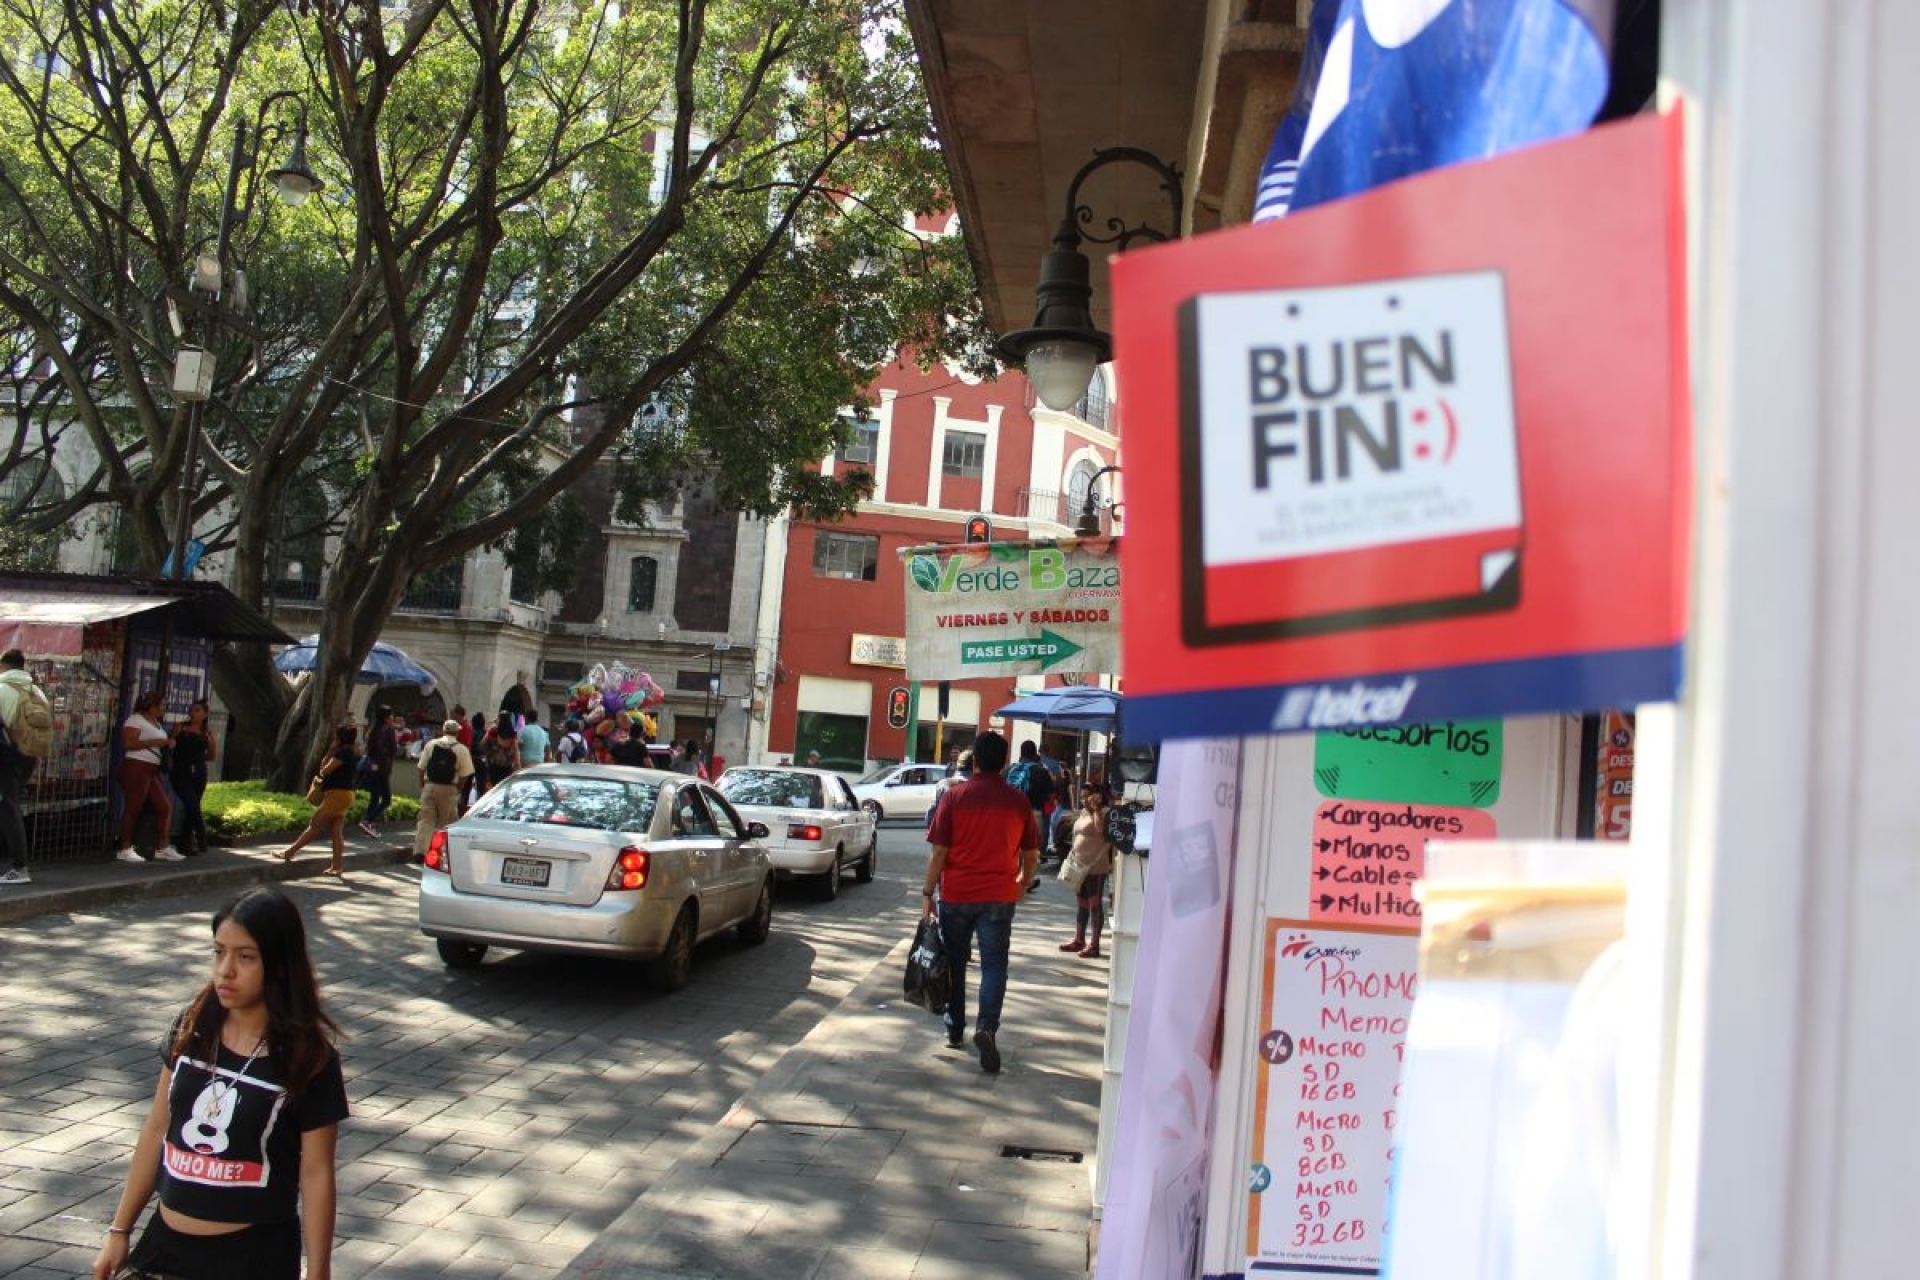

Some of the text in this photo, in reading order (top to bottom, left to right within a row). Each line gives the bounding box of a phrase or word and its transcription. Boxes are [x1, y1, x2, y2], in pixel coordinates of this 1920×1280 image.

[1248, 331, 1456, 405] BUEN
[911, 554, 1020, 594] Verde
[937, 608, 1110, 628] VIERNES Y SÁBADOS
[967, 643, 1057, 659] PASE USTED
[1331, 804, 1463, 834] Cargadores
[1333, 835, 1411, 862] Manos
[1333, 865, 1417, 886] Cables
[1298, 1036, 1366, 1058] MICRO
[1296, 1111, 1361, 1131] MICRO
[169, 1150, 244, 1180] WHO ME?
[1295, 1179, 1358, 1199] MICRO
